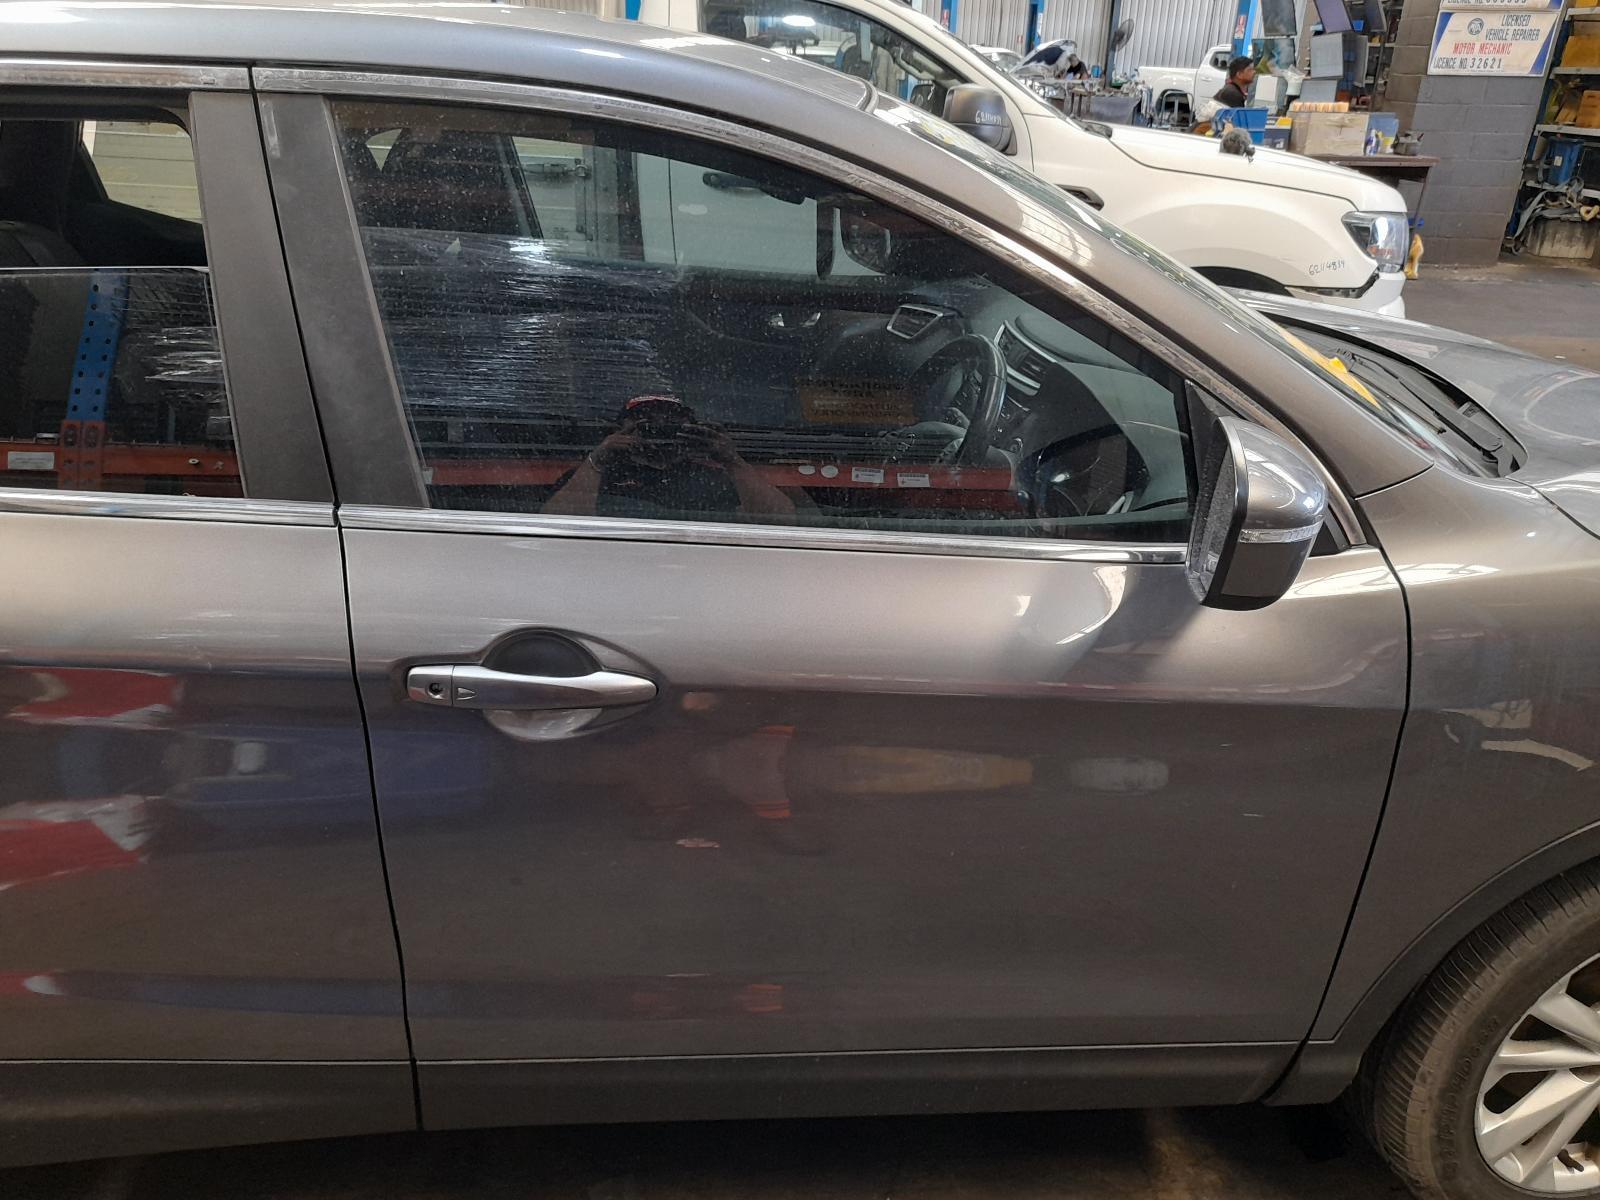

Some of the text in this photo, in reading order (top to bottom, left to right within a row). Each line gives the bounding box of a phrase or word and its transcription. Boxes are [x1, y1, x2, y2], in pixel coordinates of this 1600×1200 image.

[1502, 15, 1531, 26] LICENSED
[1486, 28, 1540, 40] VEHICLE REPAIRER
[1453, 42, 1512, 54] MOTOR MECHANIC
[1434, 58, 1456, 69] LICENCE
[1470, 58, 1502, 68] 32621
